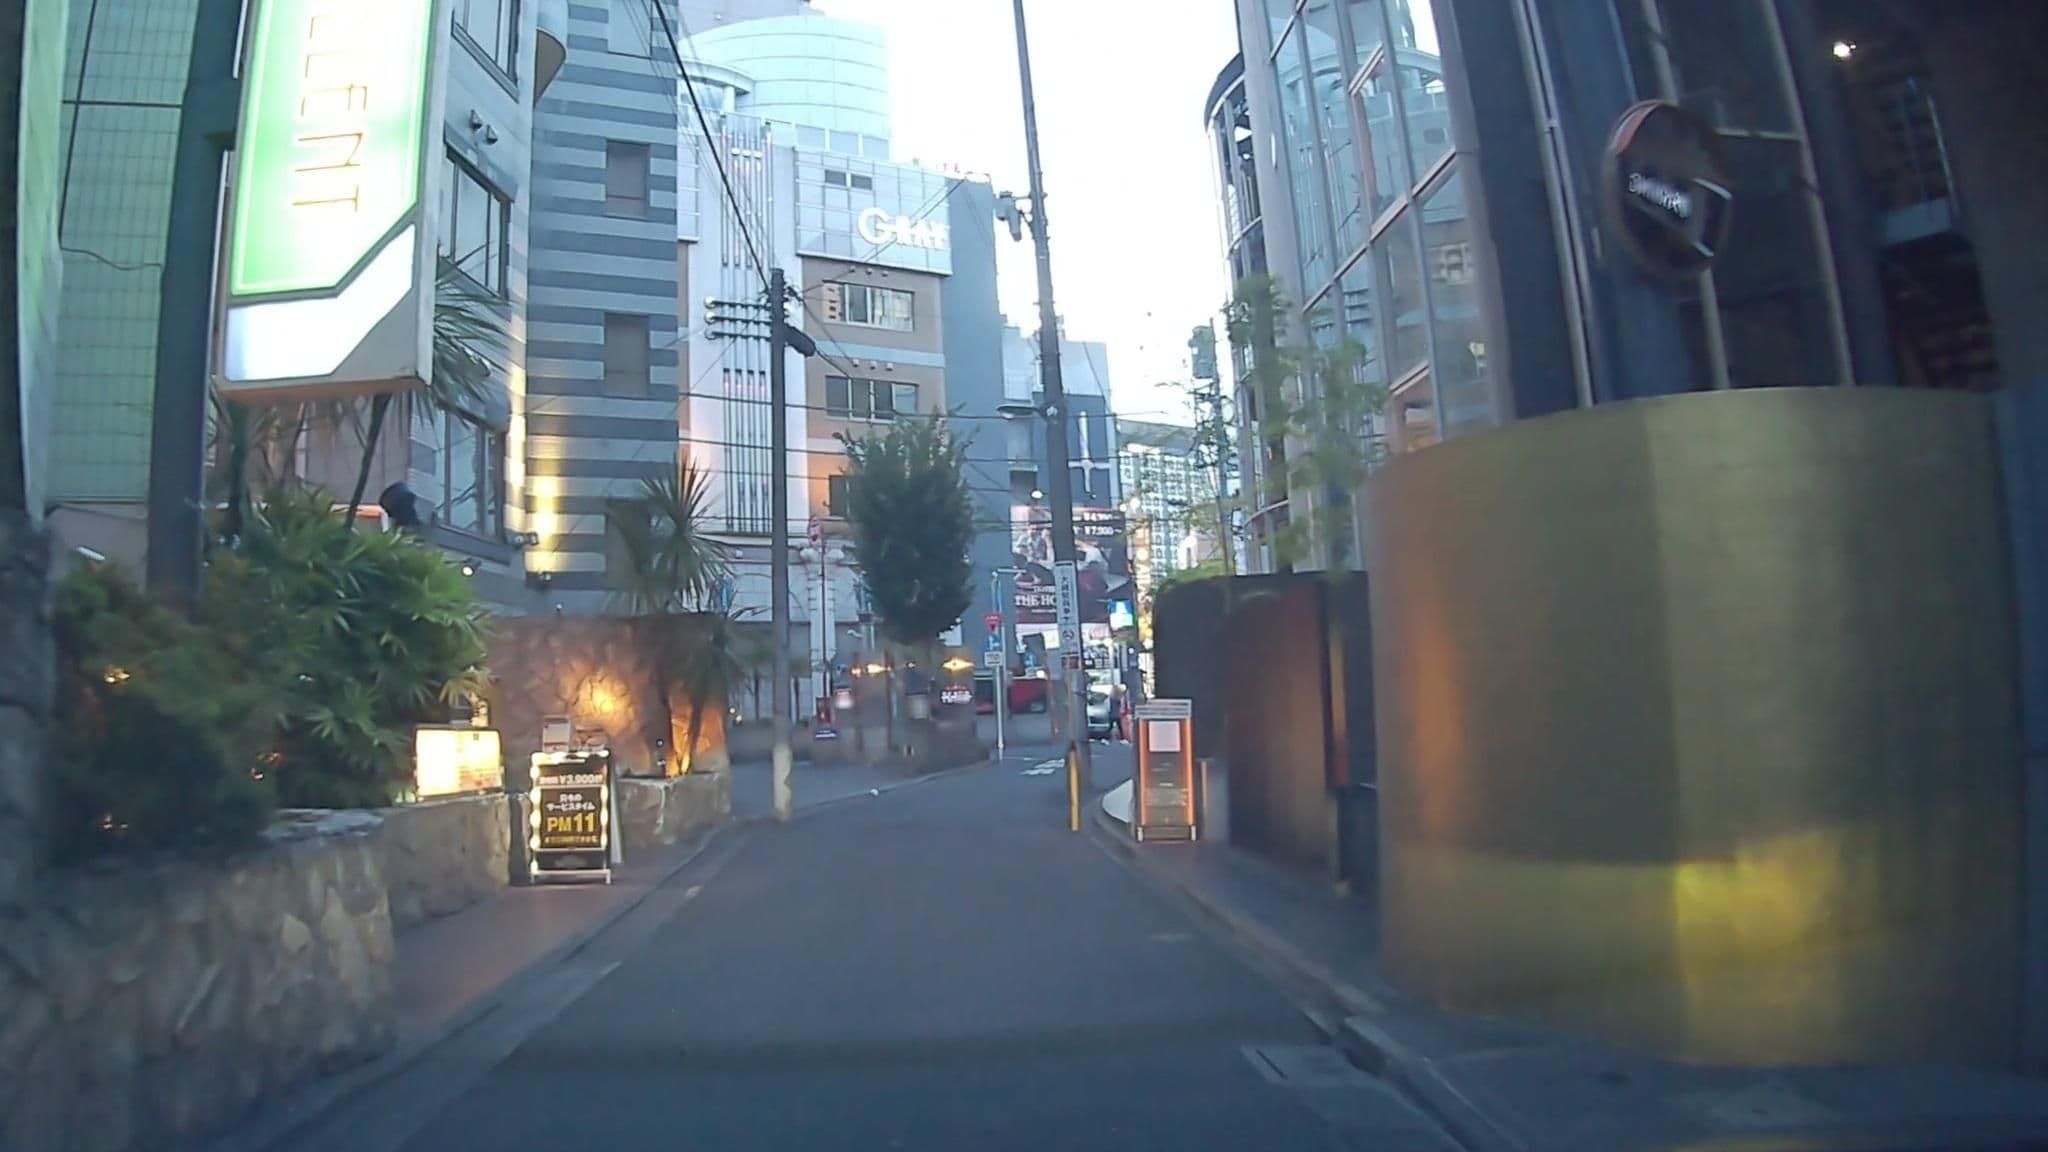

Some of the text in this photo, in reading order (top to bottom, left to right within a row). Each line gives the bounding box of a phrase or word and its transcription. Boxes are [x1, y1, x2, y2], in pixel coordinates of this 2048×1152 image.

[1015, 594, 1040, 607] THE
[546, 802, 596, 811] サービスタイム
